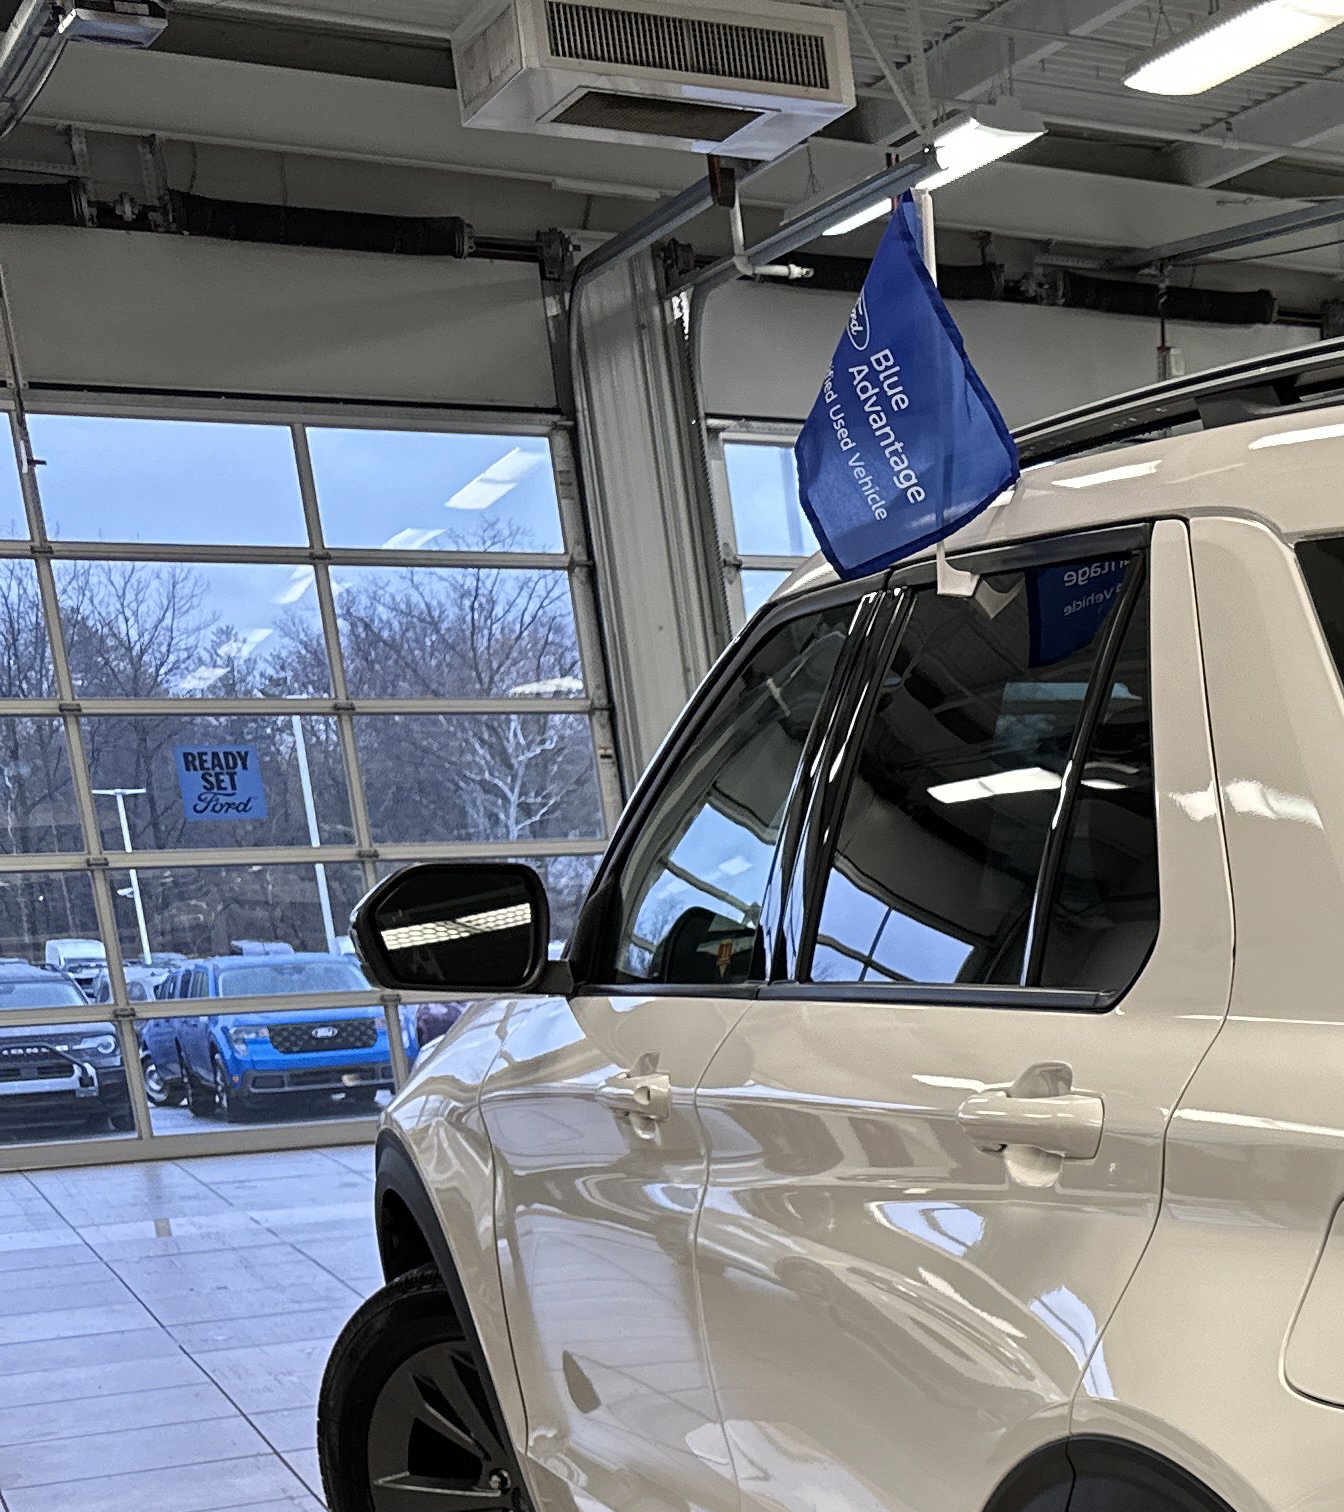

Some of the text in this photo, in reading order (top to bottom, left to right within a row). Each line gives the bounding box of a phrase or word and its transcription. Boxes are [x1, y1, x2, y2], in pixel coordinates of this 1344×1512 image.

[870, 349, 909, 412] Blue
[848, 365, 925, 504] Advantage
[829, 404, 855, 453] Used
[847, 453, 887, 521] Vehicle
[182, 751, 249, 772] READY
[201, 772, 238, 791] SET
[193, 792, 253, 814] Ford
